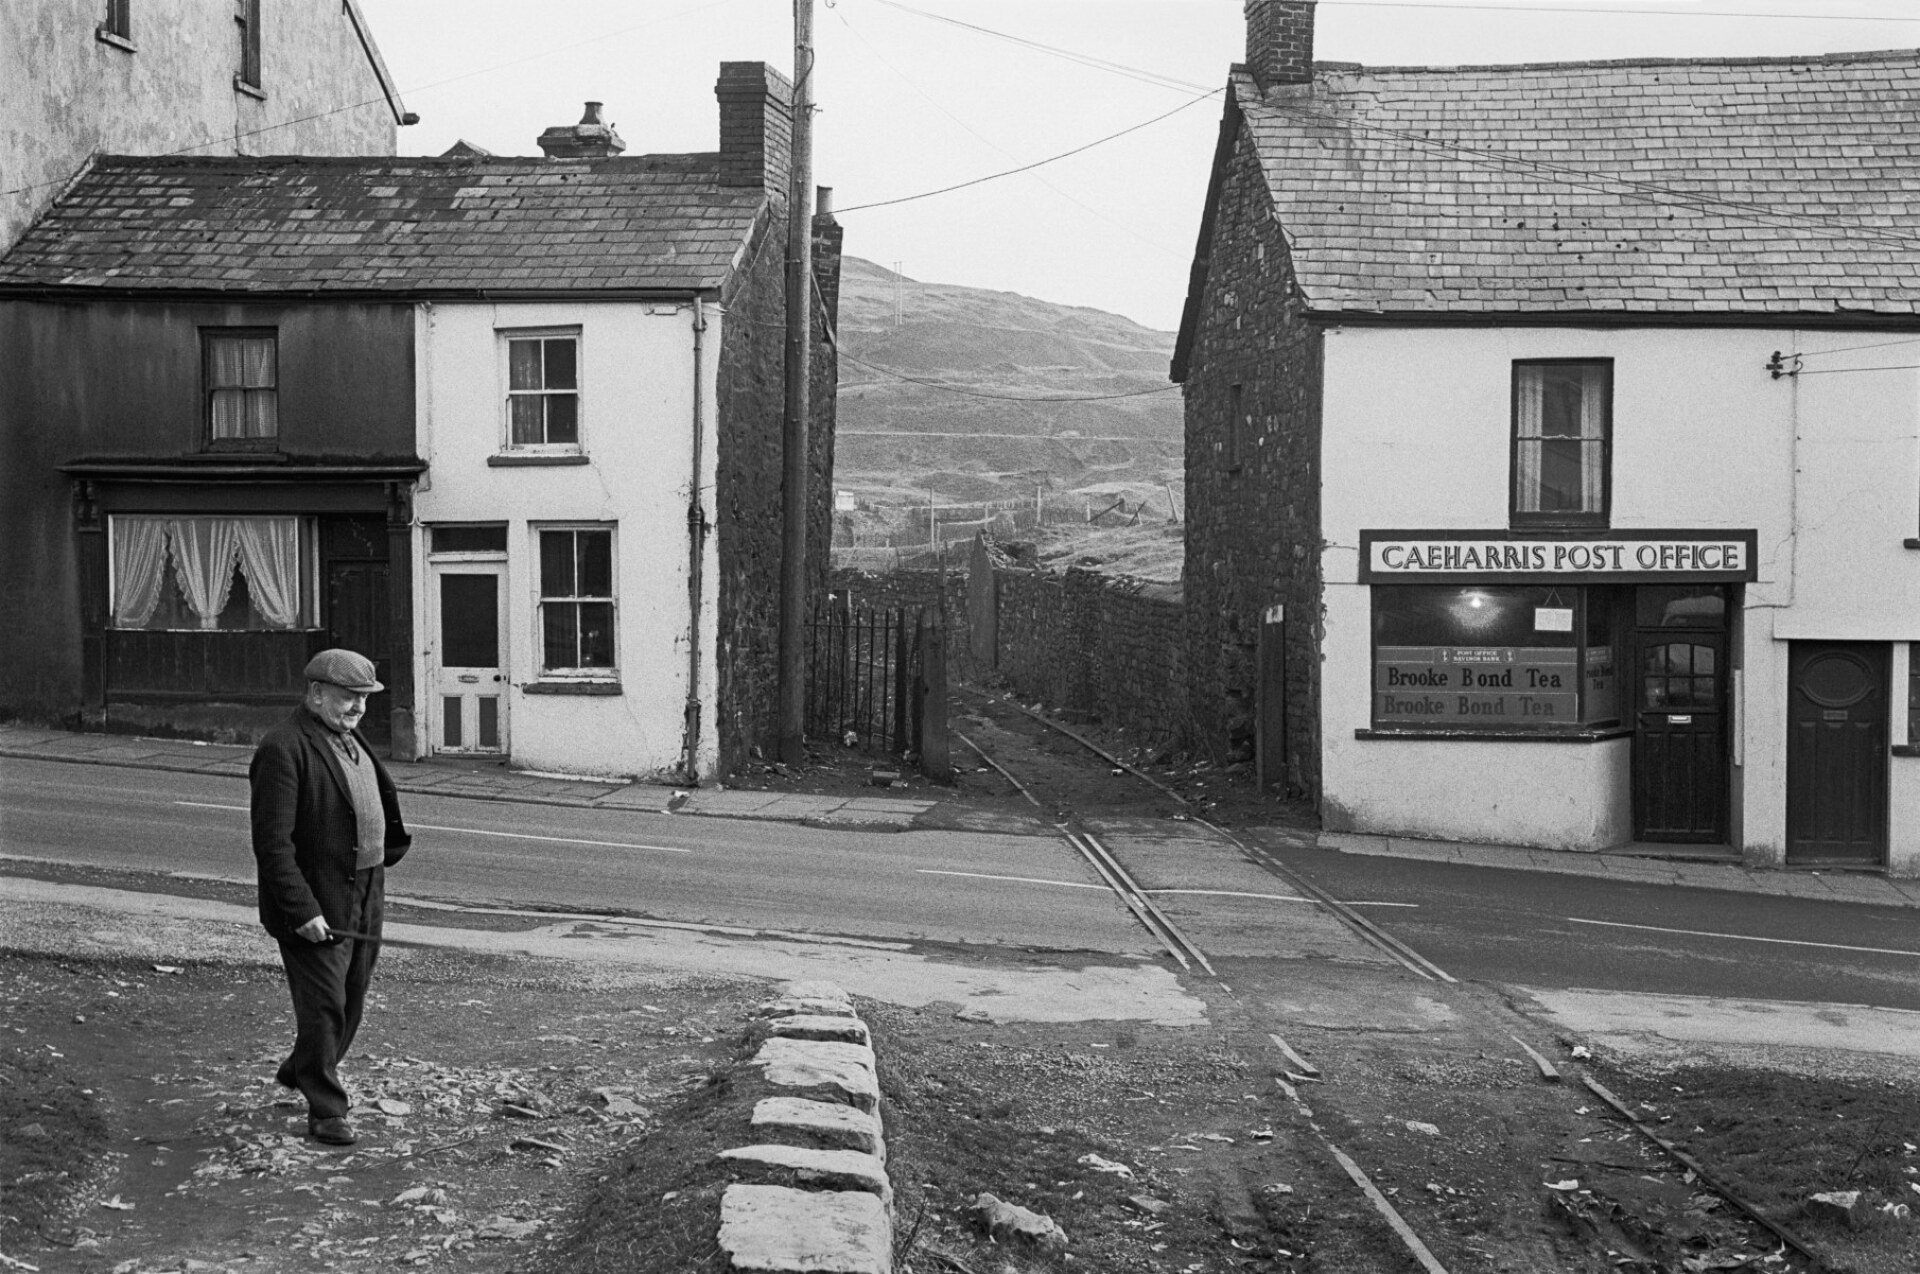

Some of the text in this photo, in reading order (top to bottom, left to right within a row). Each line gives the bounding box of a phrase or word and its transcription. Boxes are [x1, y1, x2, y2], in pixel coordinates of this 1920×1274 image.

[1382, 545, 1738, 570] CAEHARRIS POST OFFICE
[1388, 667, 1562, 688] Brooke Bond Tea
[1384, 696, 1555, 716] Brooke Bond Tea
